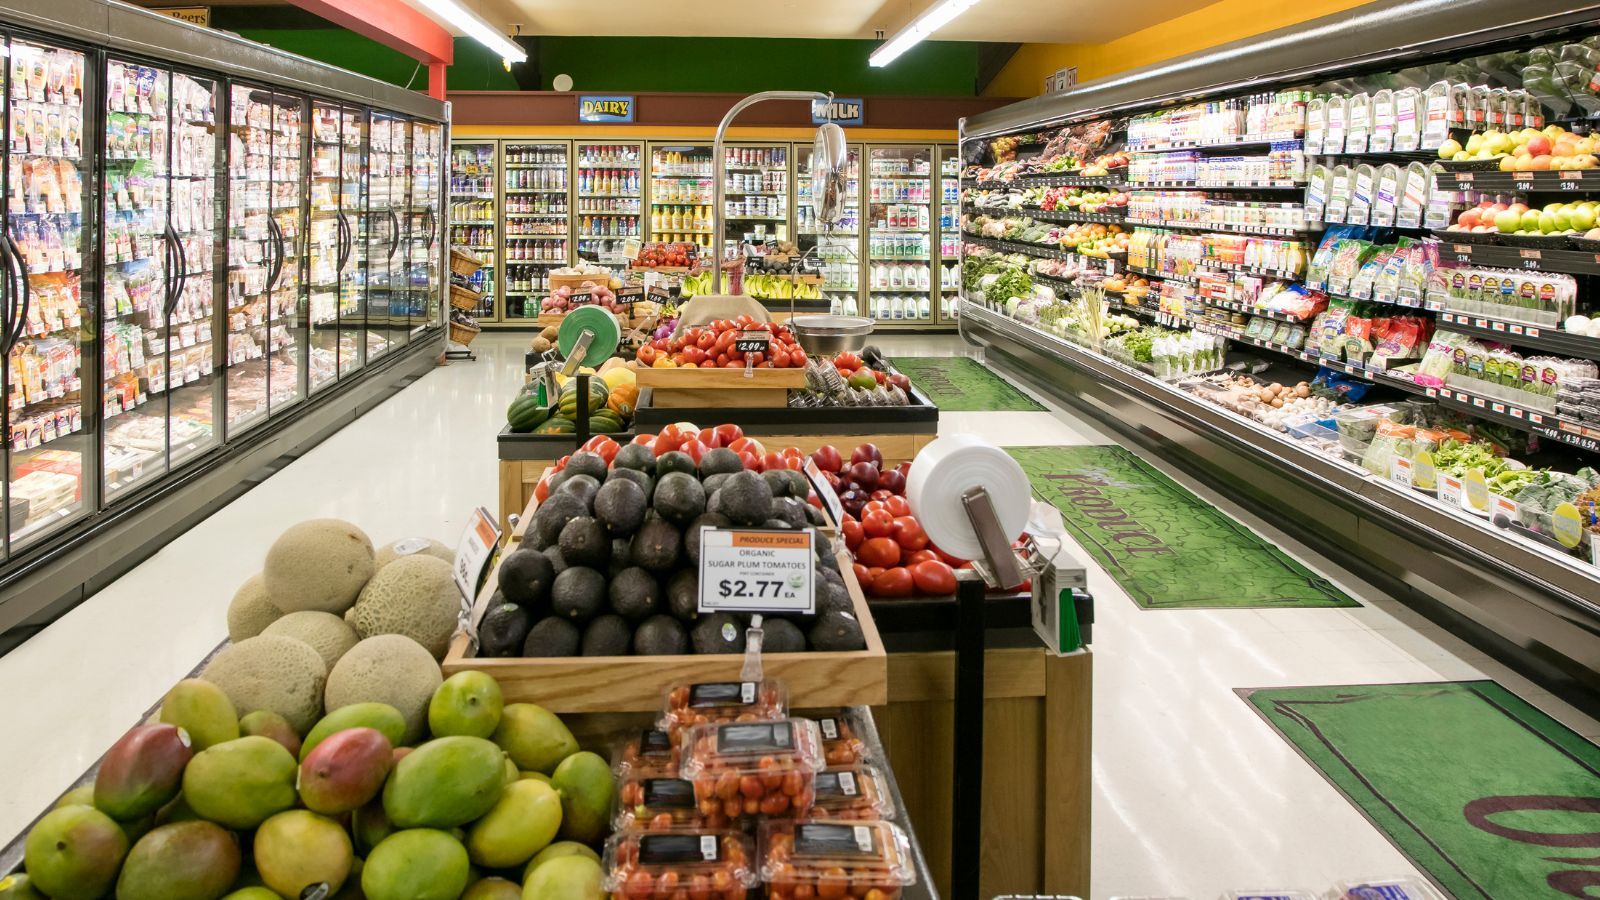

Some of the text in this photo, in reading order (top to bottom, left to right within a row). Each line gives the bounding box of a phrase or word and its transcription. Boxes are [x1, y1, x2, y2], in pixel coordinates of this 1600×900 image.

[582, 100, 630, 117] DAIRY
[814, 102, 860, 119] MILK
[739, 536, 804, 545] PRODUCE SPECIAL
[739, 549, 776, 557] ORGANIC
[707, 560, 806, 570] SUGAR PLUM TOMATOES
[718, 579, 783, 599] $2.77
